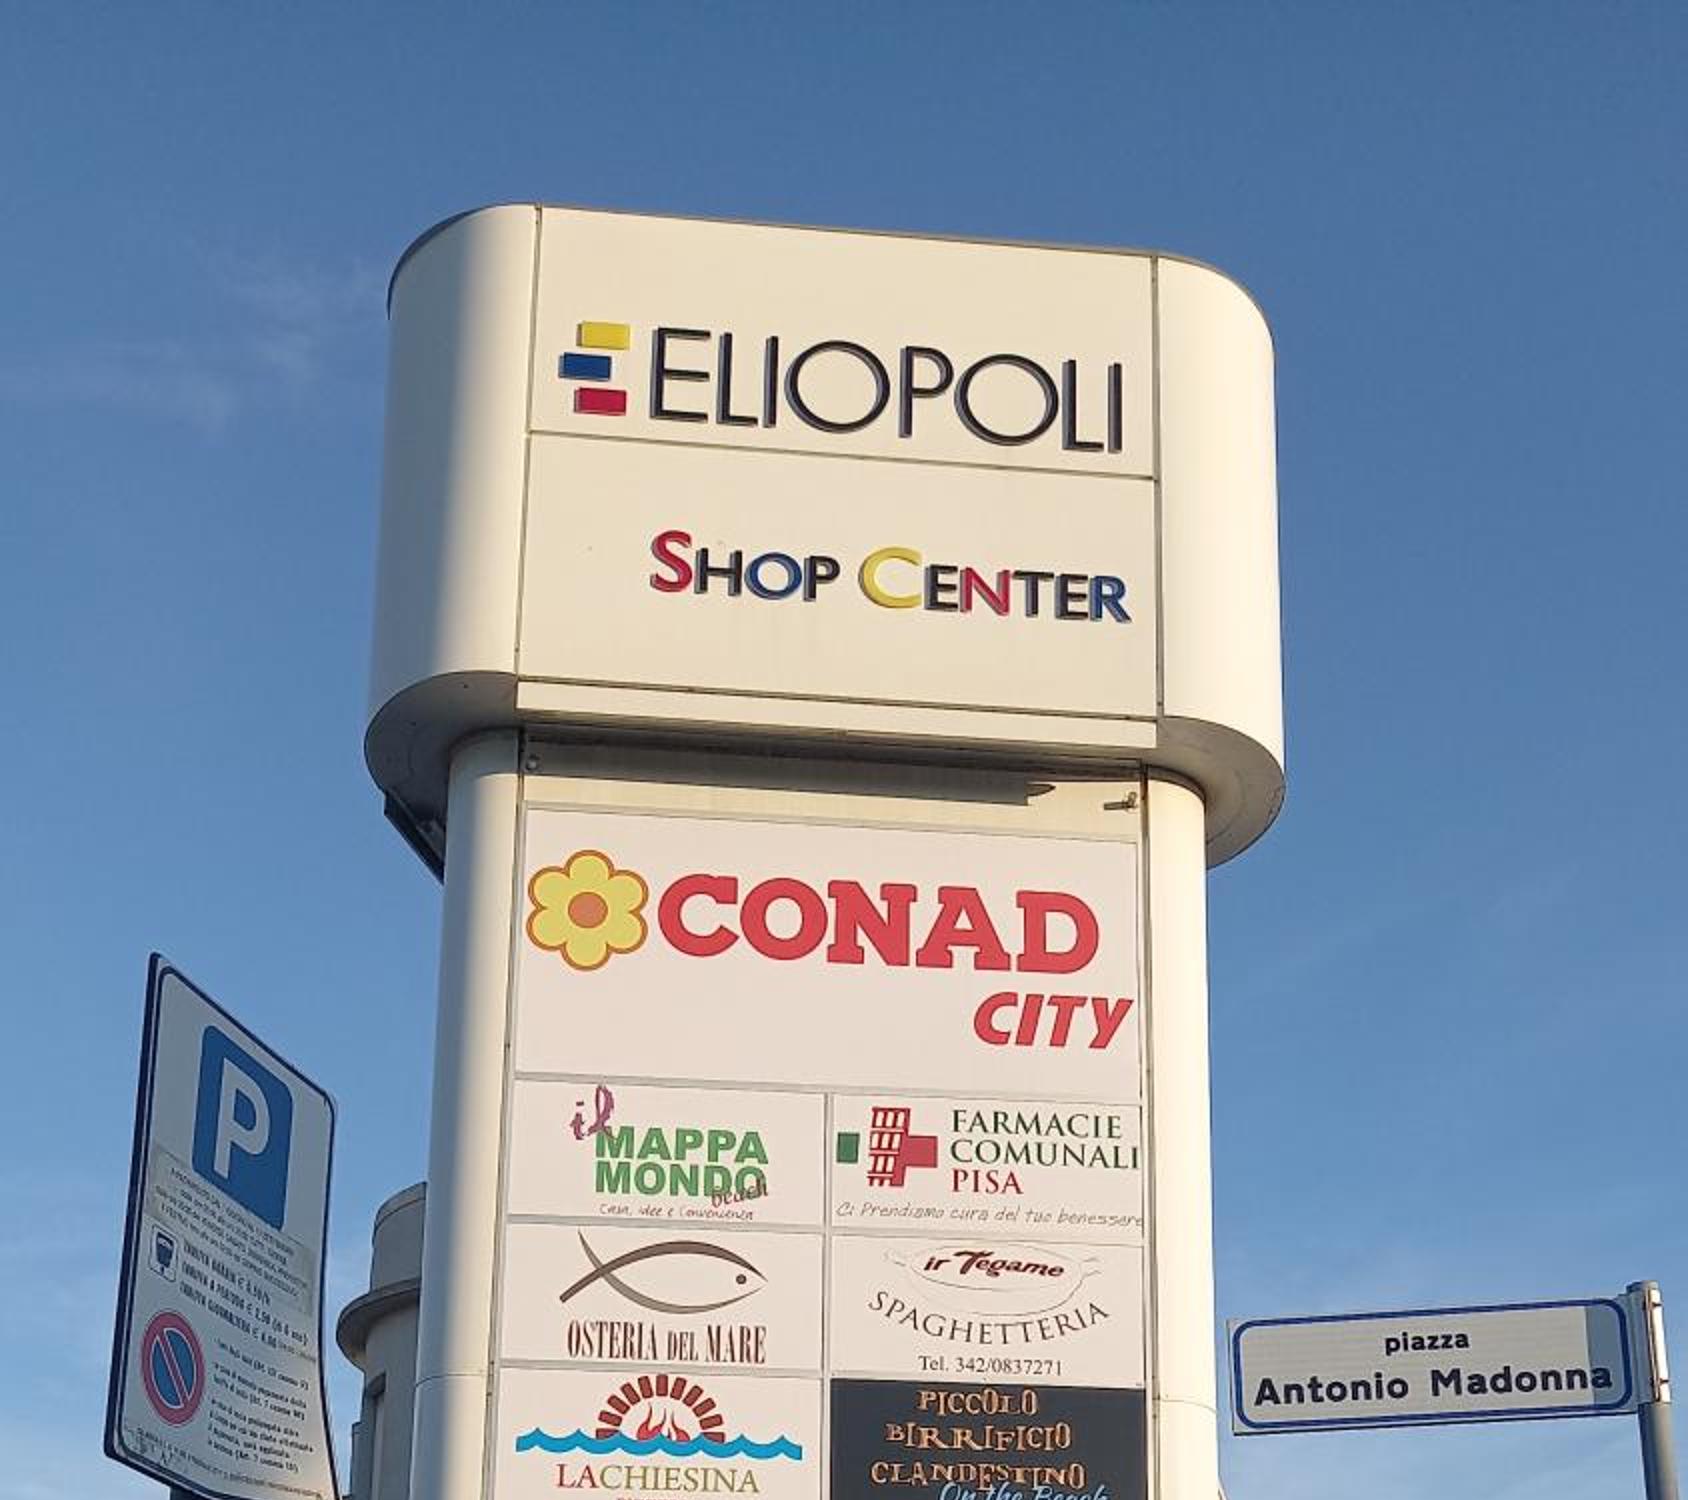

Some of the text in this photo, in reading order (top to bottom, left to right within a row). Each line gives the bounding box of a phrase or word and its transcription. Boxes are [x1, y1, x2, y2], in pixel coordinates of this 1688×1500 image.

[649, 326, 1123, 454] ELIOPOLI
[658, 873, 1100, 975] CONAD
[972, 991, 1134, 1050] CITY
[213, 1058, 270, 1179] P
[570, 1085, 617, 1140] il
[950, 1109, 1124, 1139] FARMACIE
[595, 1125, 769, 1164] MAPPA
[950, 1139, 1140, 1170] COMUNALI
[595, 1161, 767, 1197] MONDO
[950, 1169, 1024, 1195] PISA
[860, 1203, 945, 1219] Prendiamo
[950, 1209, 989, 1222] cura
[994, 1206, 1018, 1222] del
[1026, 1209, 1052, 1223] tuo
[1057, 1208, 1144, 1227] benessere
[924, 1250, 1065, 1277] ir Tegame
[868, 1291, 1110, 1345] SPAGHETTERIA
[567, 1319, 767, 1364] OSTERIA DEL MARE
[1385, 1331, 1470, 1356] piazza
[918, 1355, 1062, 1376] Tel. 342/0837271
[1254, 1365, 1613, 1406] Antonio Madonna
[918, 1388, 1038, 1417] PICCOLO
[886, 1422, 1071, 1450] BIRRIFICIO
[556, 1463, 760, 1493] LACHIESINA
[870, 1461, 1087, 1491] CLANDESTINO
